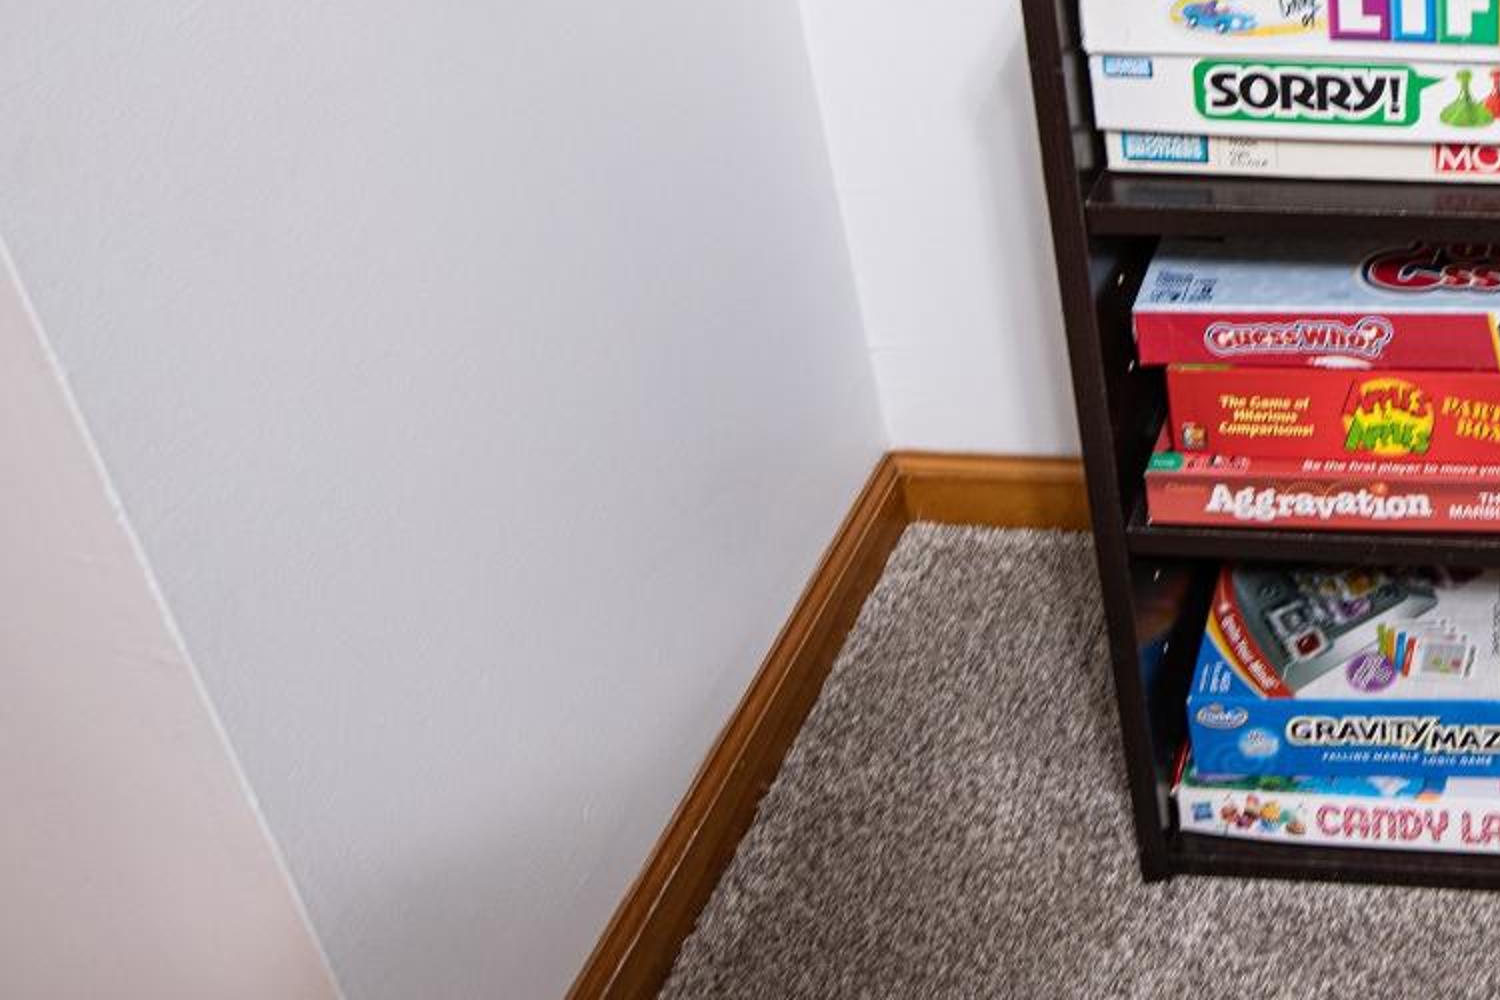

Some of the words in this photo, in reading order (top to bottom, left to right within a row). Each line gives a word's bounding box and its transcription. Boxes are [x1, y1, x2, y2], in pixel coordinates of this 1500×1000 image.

[1207, 70, 1402, 116] SORRY!
[1219, 394, 1246, 409] The
[1250, 395, 1290, 411] Game
[1233, 409, 1299, 423] Hilarious
[1377, 461, 1419, 476] player
[1203, 483, 1433, 521] Aggravation
[1288, 716, 1440, 747] GRAVITY
[1315, 804, 1449, 842] CANDY
